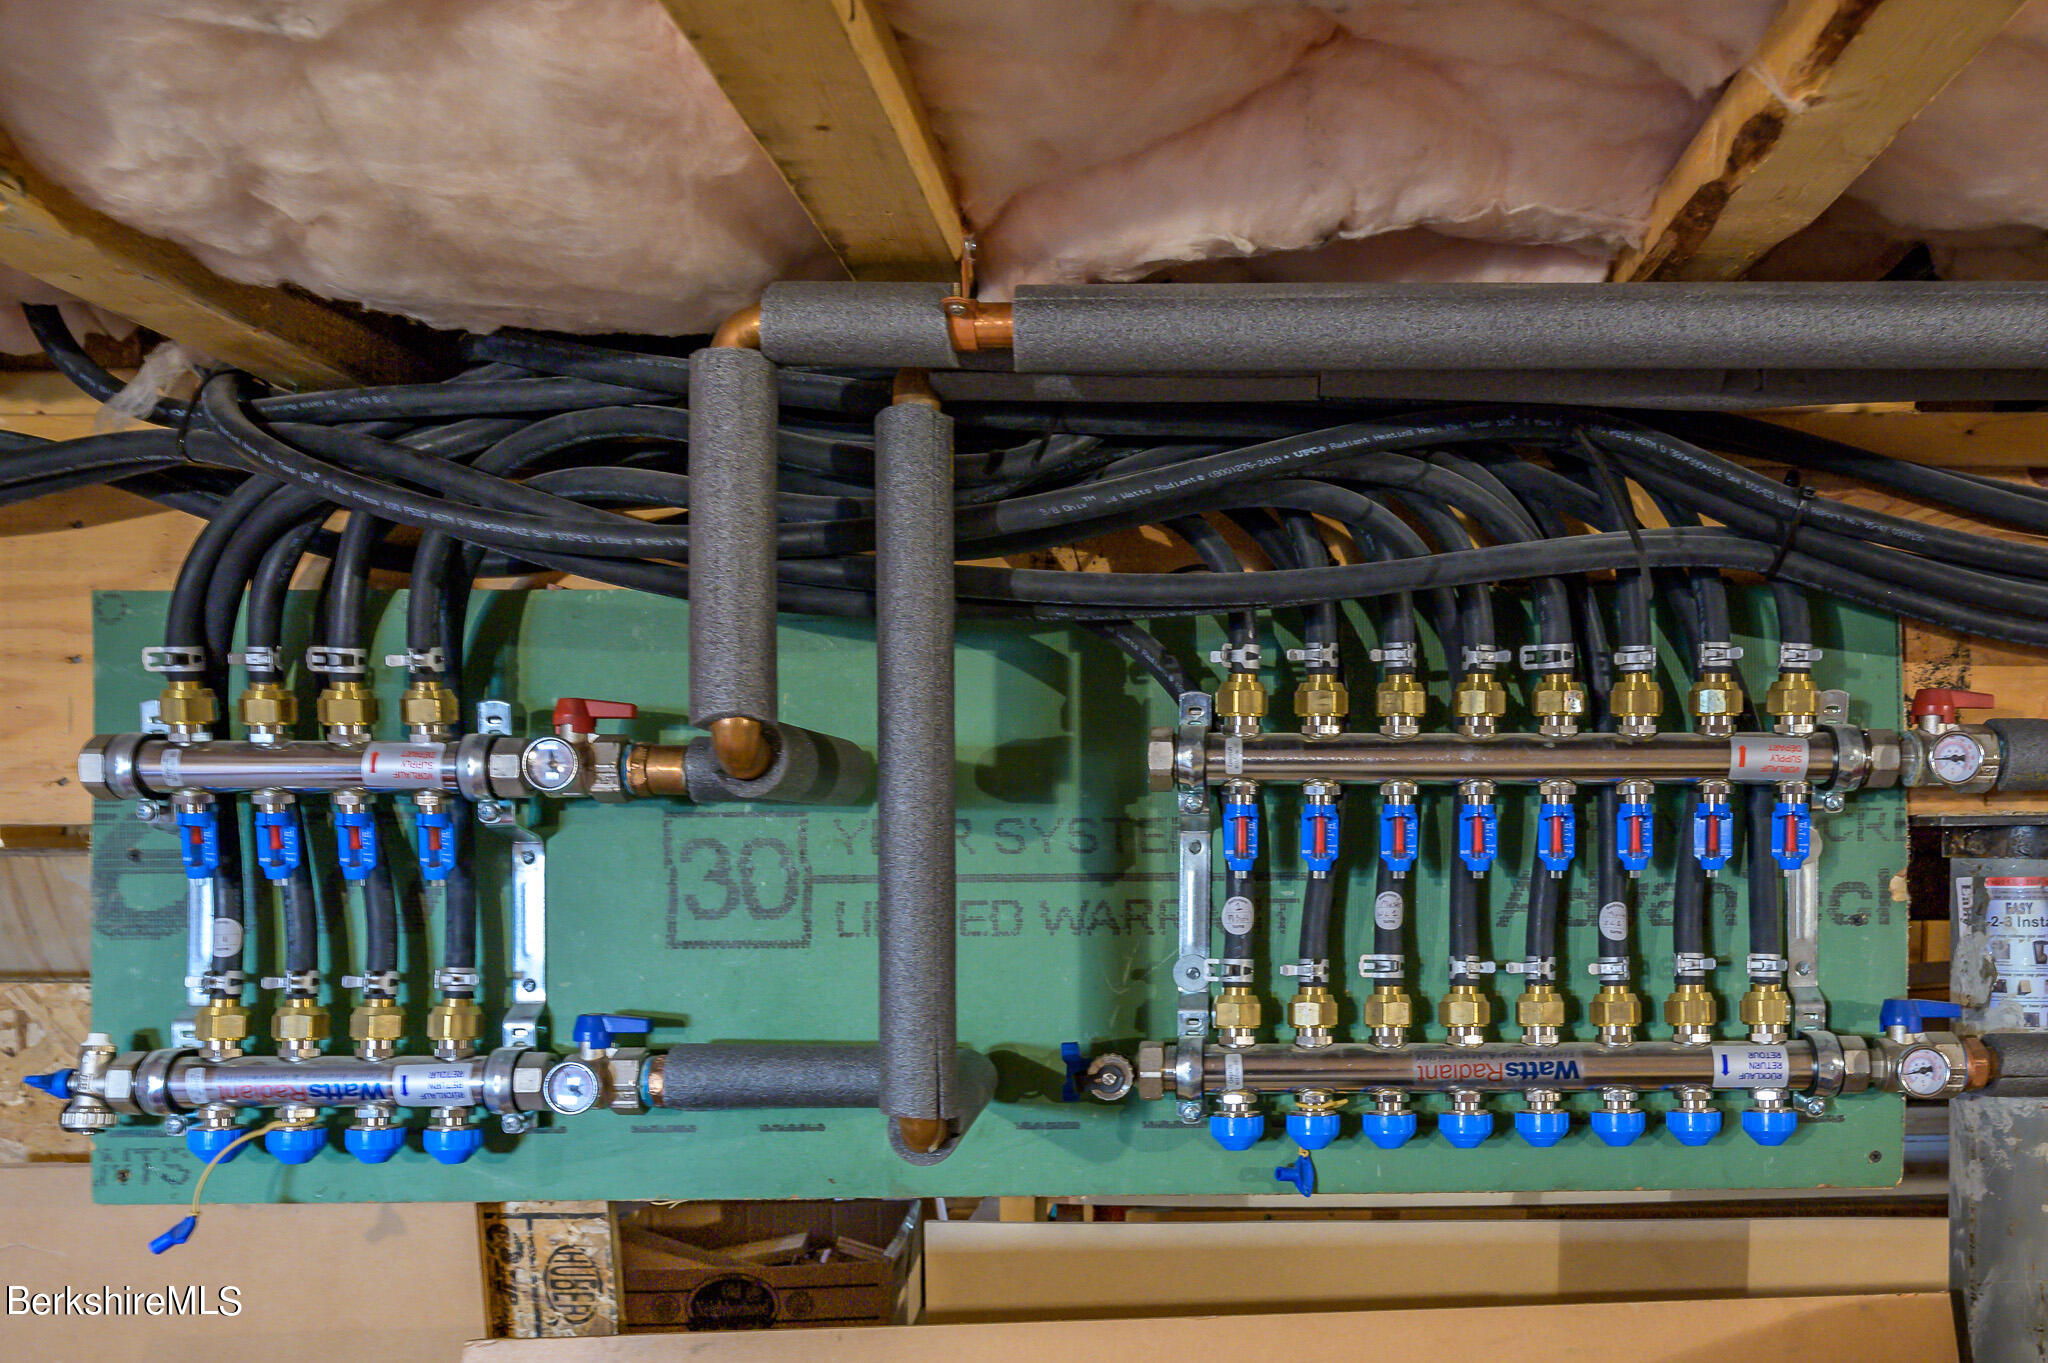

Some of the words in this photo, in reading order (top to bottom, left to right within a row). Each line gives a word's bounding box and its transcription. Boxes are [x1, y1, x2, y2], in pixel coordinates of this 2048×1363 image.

[1768, 754, 1803, 763] SUPPLY
[994, 817, 1179, 855] SYSTE
[680, 837, 798, 920] 30
[2005, 902, 2033, 914] EASY
